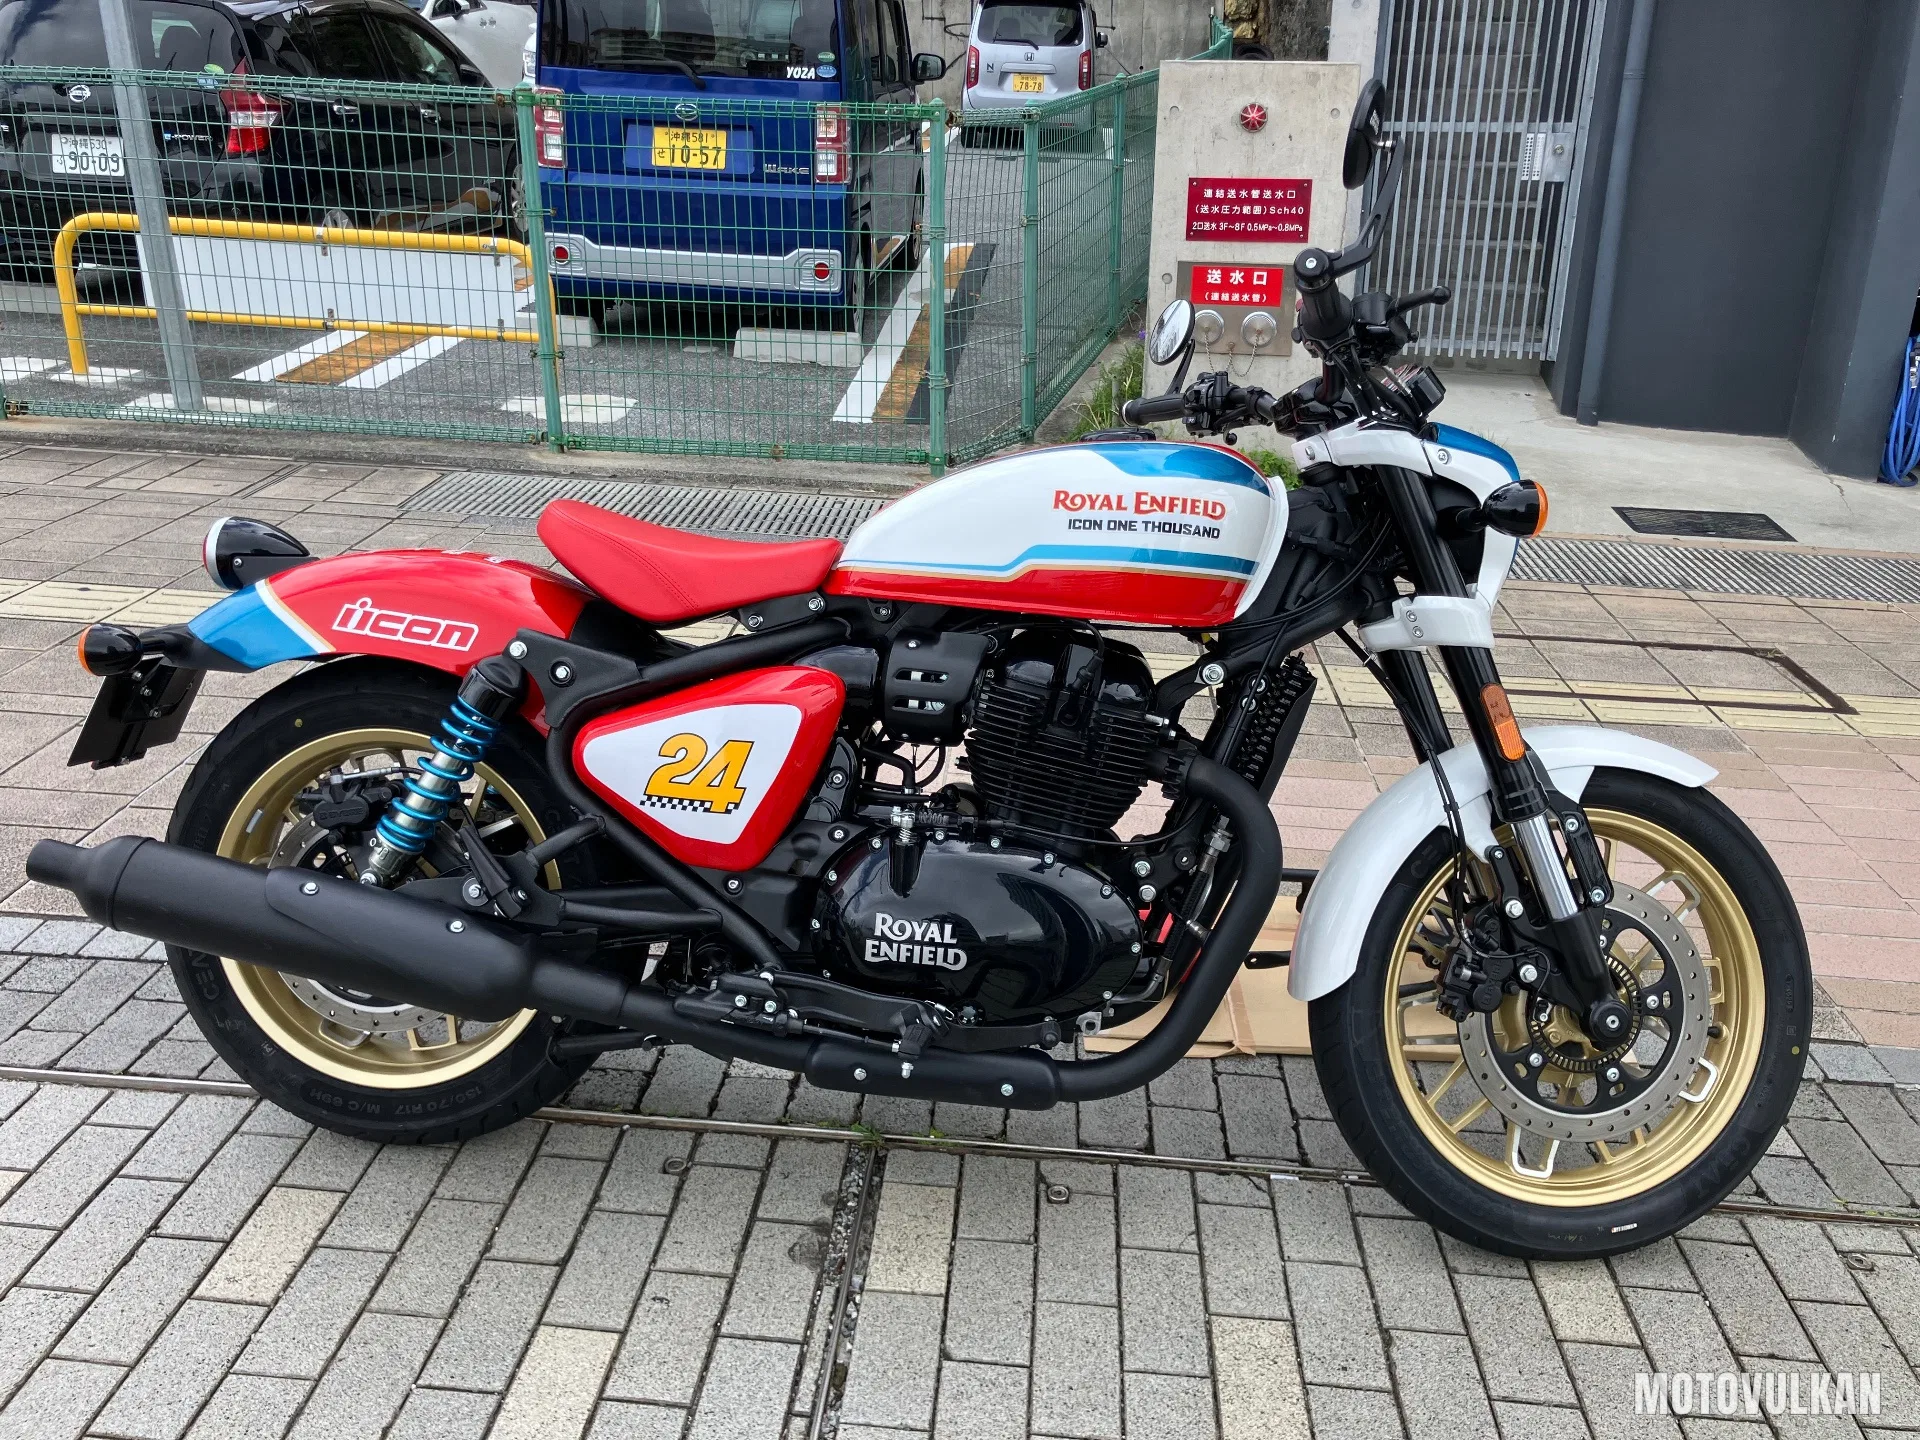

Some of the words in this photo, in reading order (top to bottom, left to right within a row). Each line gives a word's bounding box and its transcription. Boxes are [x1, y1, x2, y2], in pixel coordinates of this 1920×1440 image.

[786, 66, 816, 79] YOZA
[1019, 81, 1042, 91] 78-78
[68, 151, 120, 173] 90-09
[670, 144, 722, 166] 10-57
[1203, 188, 1296, 199] 連結送水管送水口
[1206, 268, 1268, 286] 送水口
[1052, 489, 1128, 512] ROYAL
[1133, 491, 1227, 521] ENFIELD
[1068, 518, 1103, 531] ICON
[1106, 519, 1138, 532] ONE
[1141, 520, 1221, 540] THOUSAND
[643, 732, 755, 813] 24
[873, 912, 958, 944] ROYAL
[864, 938, 968, 971] ENFIELD
